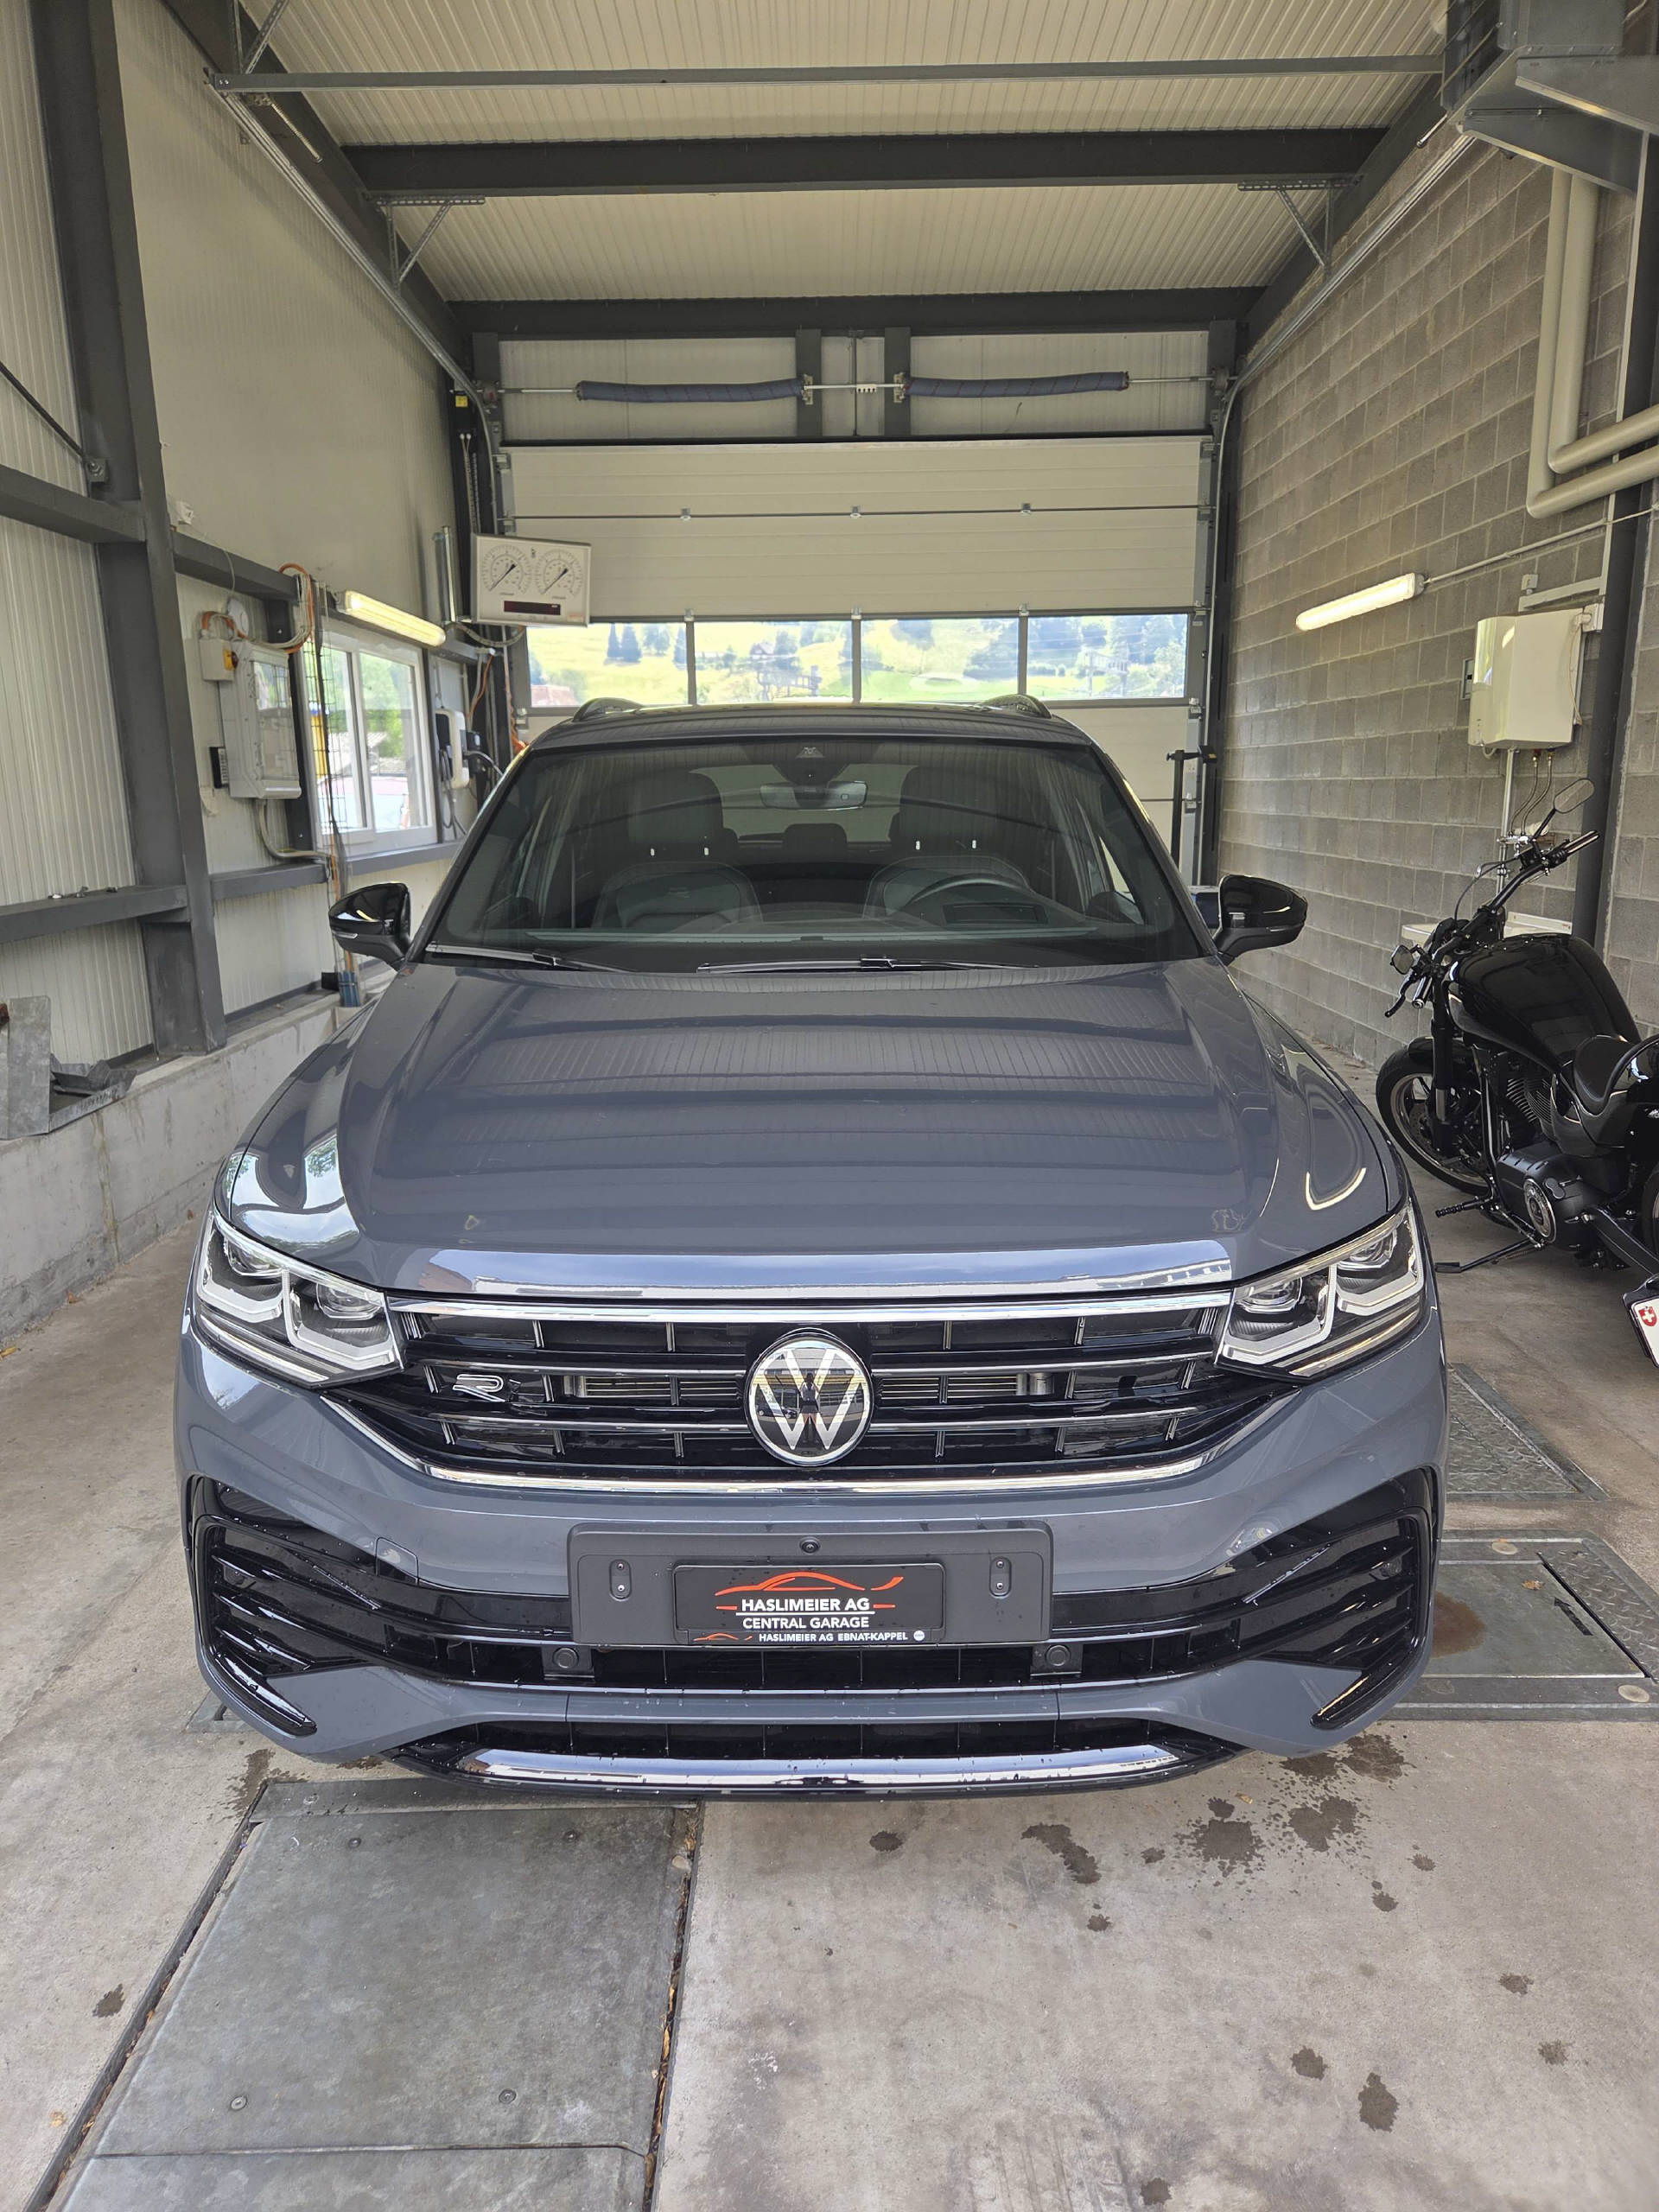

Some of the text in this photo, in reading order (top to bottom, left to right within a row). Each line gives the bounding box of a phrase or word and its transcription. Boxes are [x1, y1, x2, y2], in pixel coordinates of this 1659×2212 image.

[741, 1597, 871, 1612] HASLIMEIER AG
[742, 1616, 870, 1630] CENTRAL GARAGE
[759, 1633, 817, 1643] HASLIMEIER
[818, 1632, 835, 1642] AG
[837, 1631, 909, 1642] EBNAT-KAPPEL
